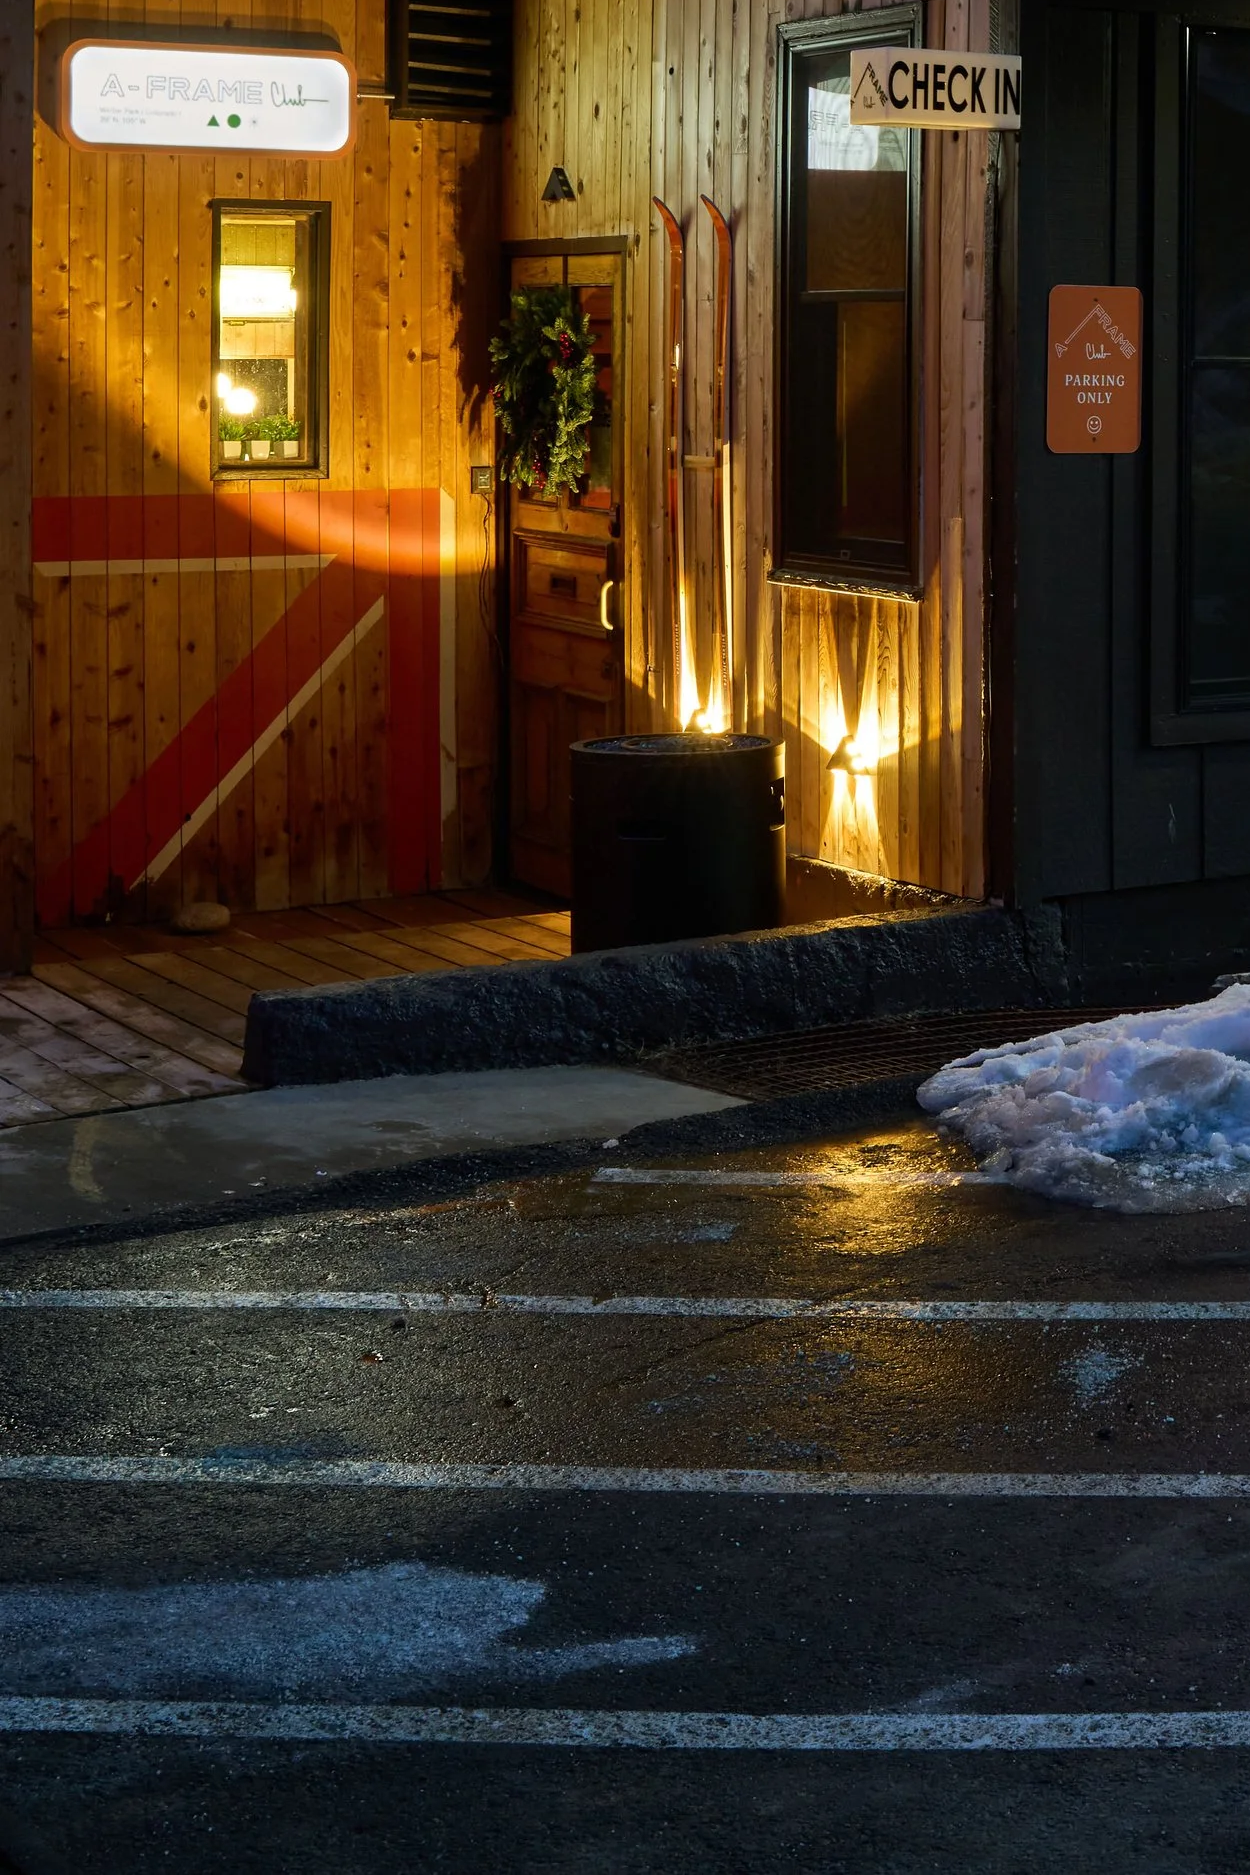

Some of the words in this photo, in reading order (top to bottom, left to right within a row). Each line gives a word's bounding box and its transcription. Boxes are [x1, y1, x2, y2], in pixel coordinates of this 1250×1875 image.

[270, 80, 329, 108] Club
[888, 60, 987, 114] CHECK
[994, 68, 1021, 116] IN
[1094, 304, 1137, 359] FRAME
[1085, 343, 1112, 360] Club
[1065, 374, 1125, 387] PARKING
[1077, 391, 1112, 404] ONLY
